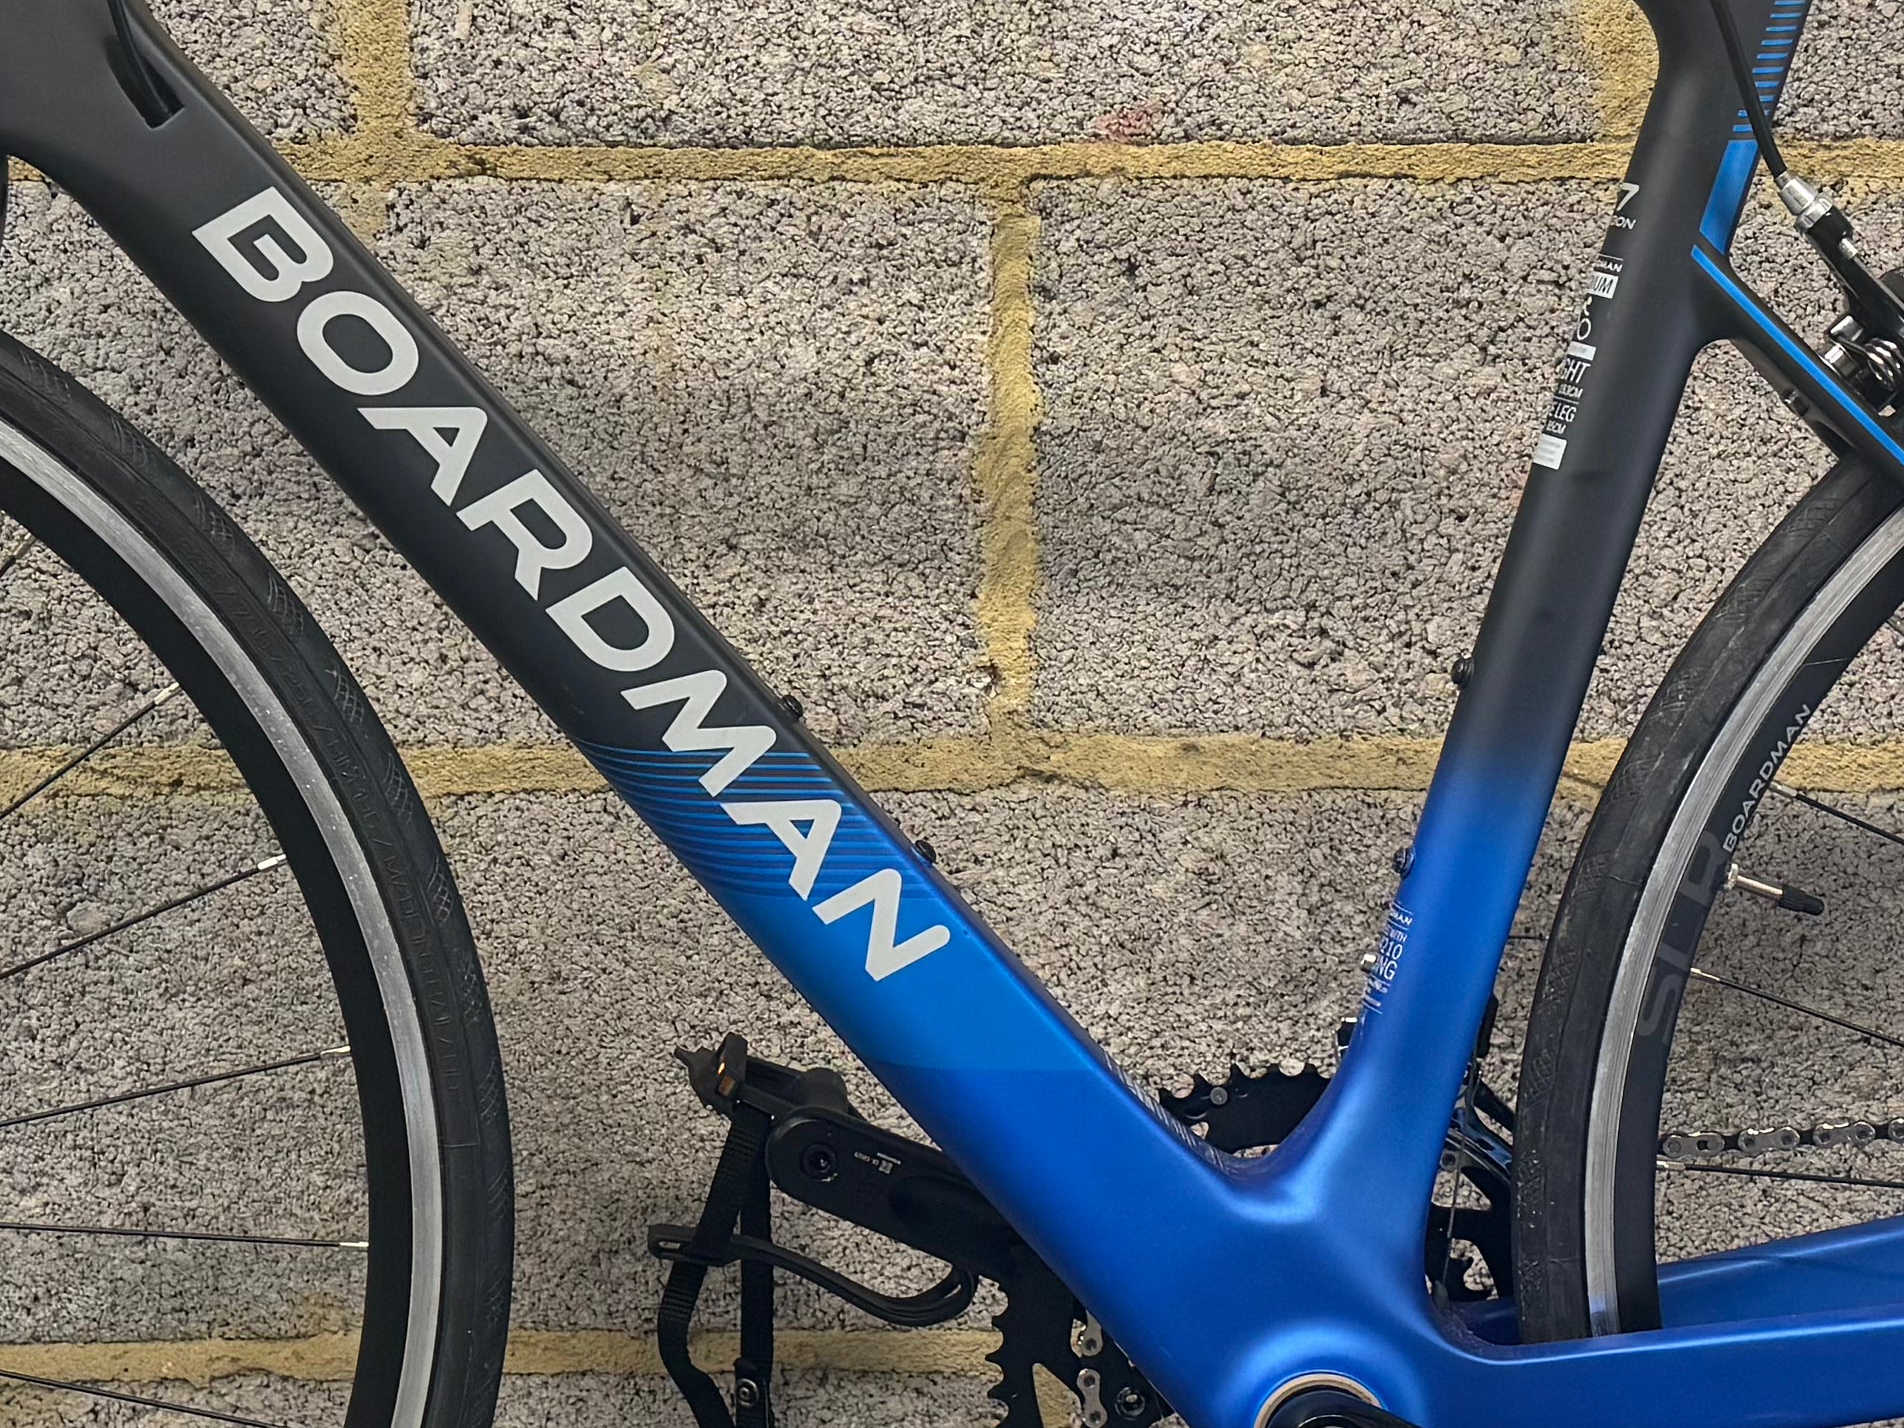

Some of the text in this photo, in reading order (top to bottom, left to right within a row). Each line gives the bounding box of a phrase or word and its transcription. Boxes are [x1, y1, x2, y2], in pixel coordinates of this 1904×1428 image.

[192, 186, 951, 981] BOARDMAN
[1636, 704, 1812, 1044] SLR BOARDMAN
